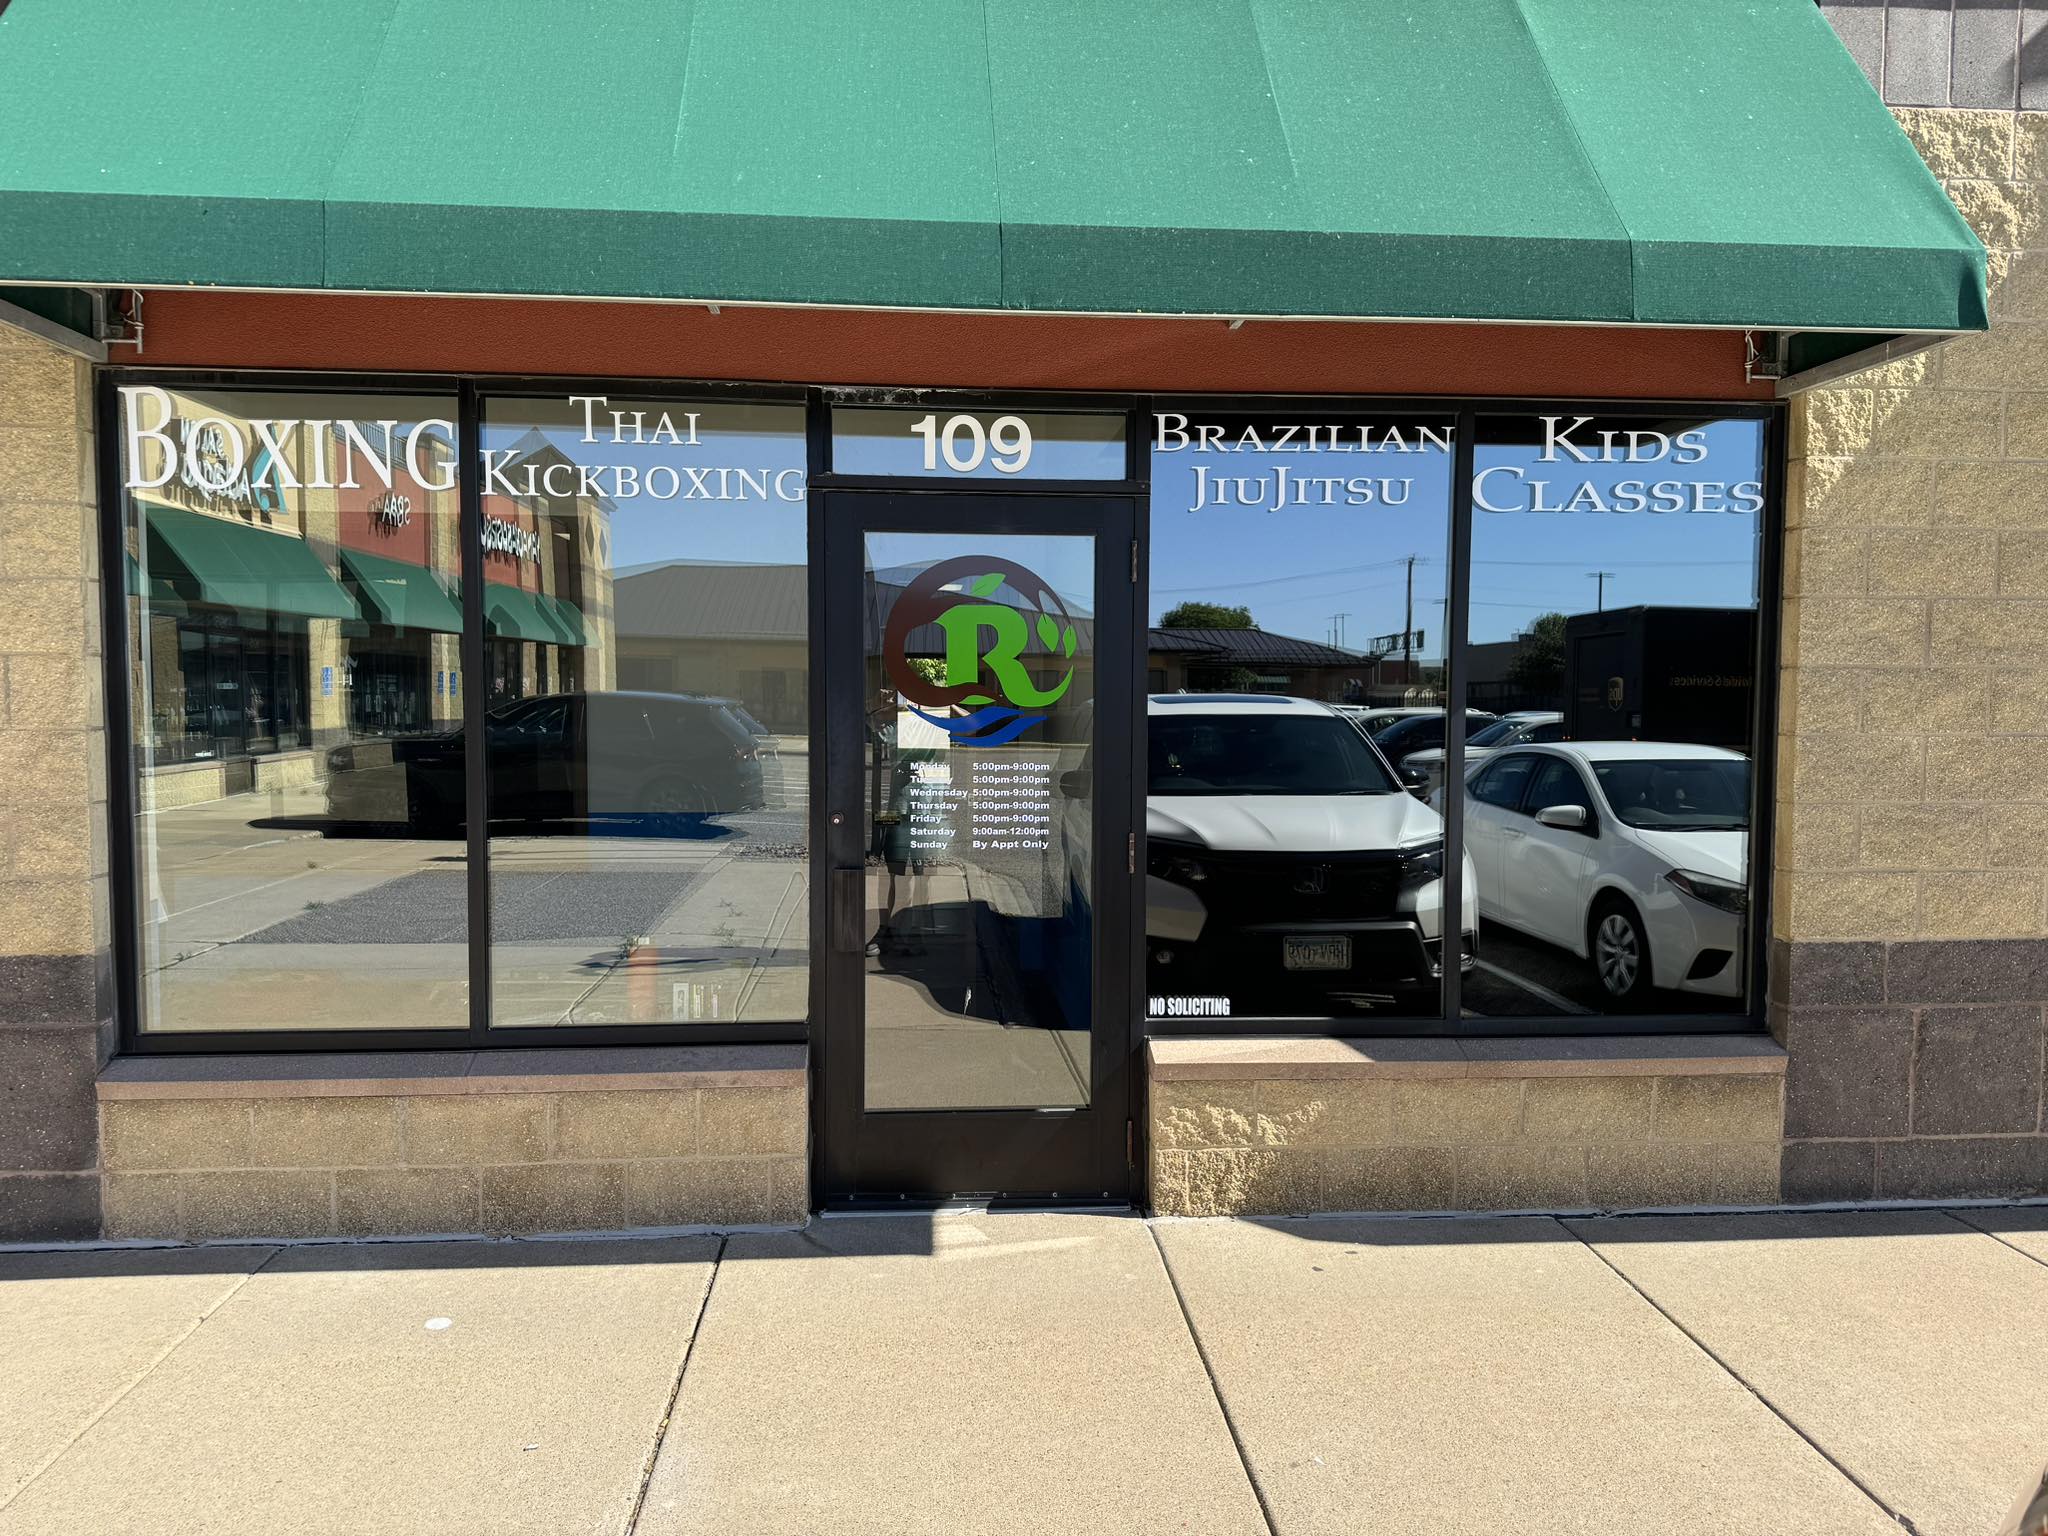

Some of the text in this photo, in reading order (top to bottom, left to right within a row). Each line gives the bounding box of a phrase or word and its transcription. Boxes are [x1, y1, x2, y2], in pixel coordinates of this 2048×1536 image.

[1152, 413, 1456, 453] BRAZILIAN
[118, 386, 459, 491] BOXING
[911, 414, 1032, 474] 109
[479, 450, 808, 502] KICKBOXING
[1472, 466, 1765, 513] CLASSES
[972, 762, 1050, 772] 5:00pm-9:00pm
[972, 775, 1050, 785] 5:00pm-9:00pm
[910, 788, 1050, 798] Wednesday 5:00pm-9:00pm
[910, 801, 1050, 811] Thursday 5:00pm-9:00pm
[910, 814, 1050, 824] Friday 5:00pm-9:00pm
[910, 827, 1050, 837] Saturday 9:00am-12:00pm
[910, 840, 1050, 850] Sunday By Appt Only
[1149, 997, 1231, 1016] NO SOLICITING
